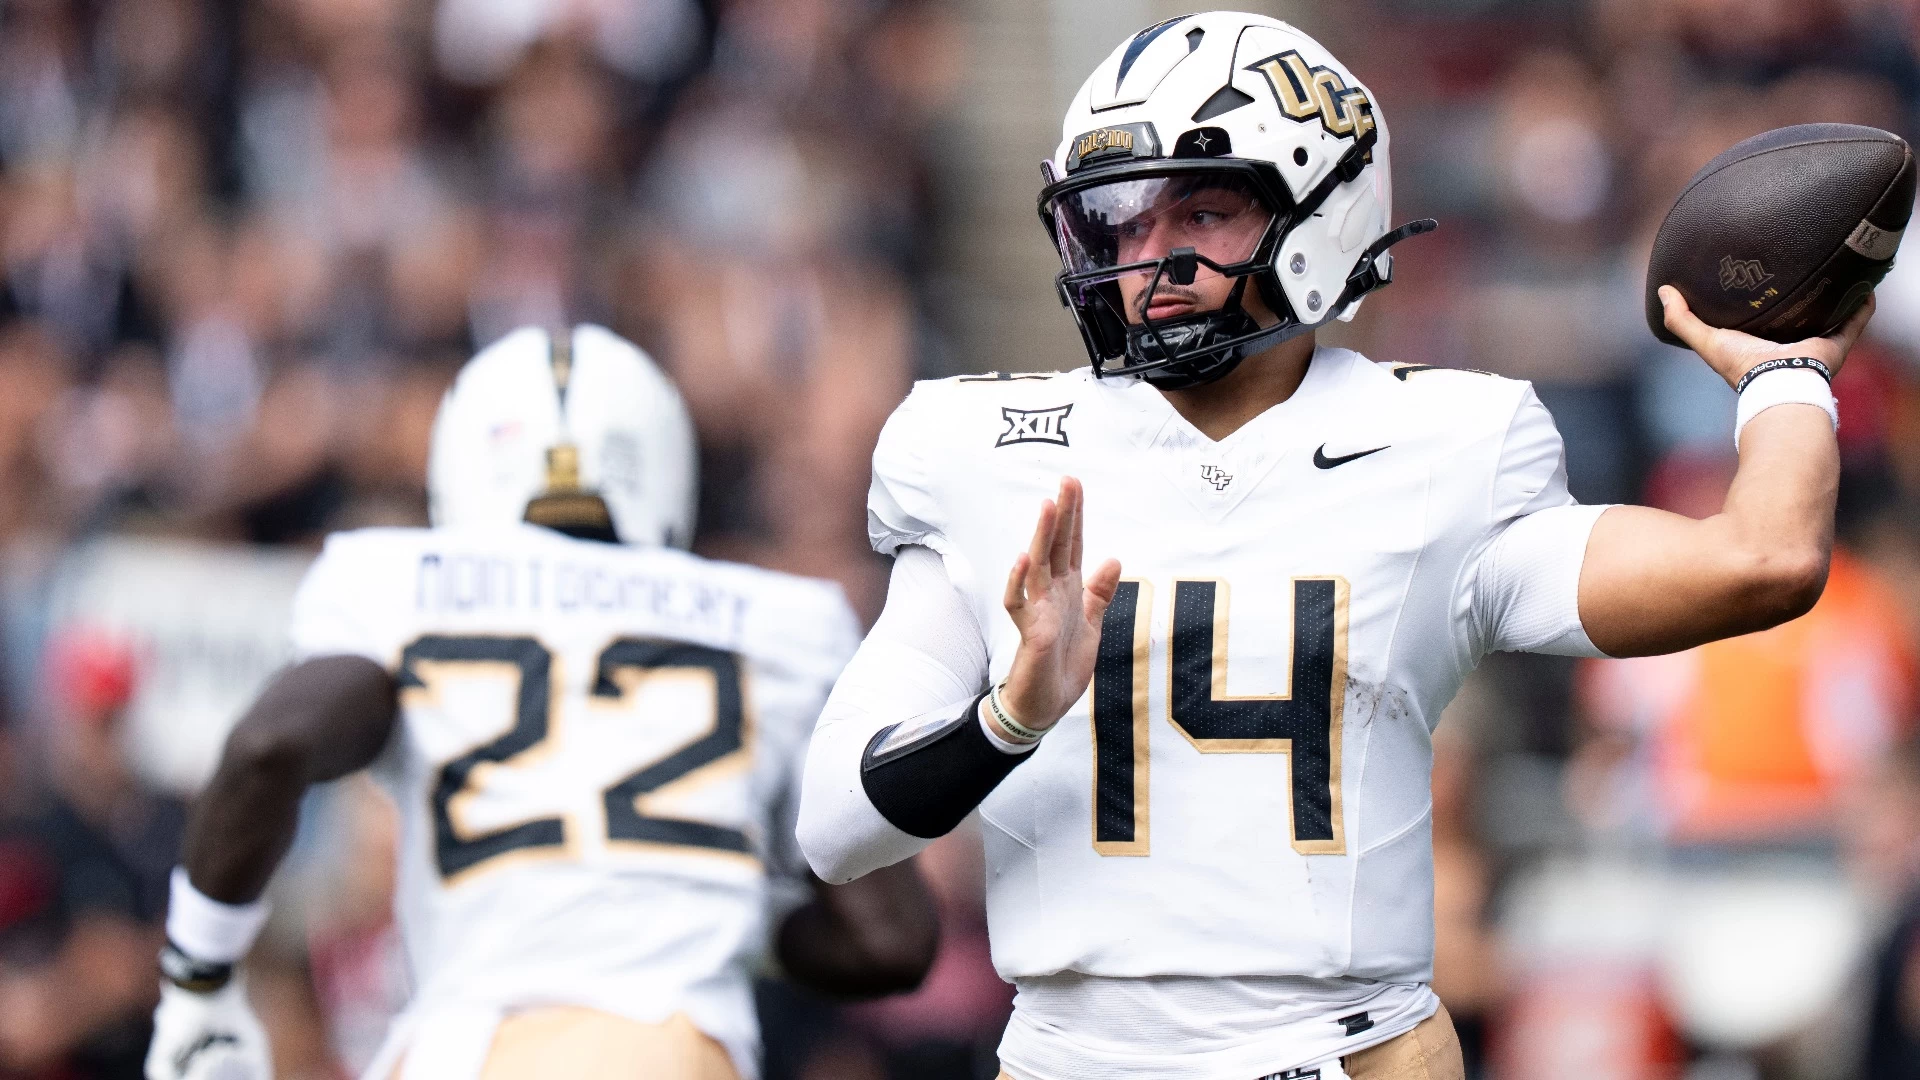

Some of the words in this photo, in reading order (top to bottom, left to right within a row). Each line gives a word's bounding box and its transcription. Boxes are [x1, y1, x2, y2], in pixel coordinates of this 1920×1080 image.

[1242, 49, 1377, 163] UCF
[1718, 255, 1775, 292] UCF
[1750, 359, 1788, 377] WORK
[995, 403, 1074, 448] XII
[1200, 464, 1233, 491] UCF
[1084, 574, 1351, 857] 14
[399, 633, 765, 889] 22
